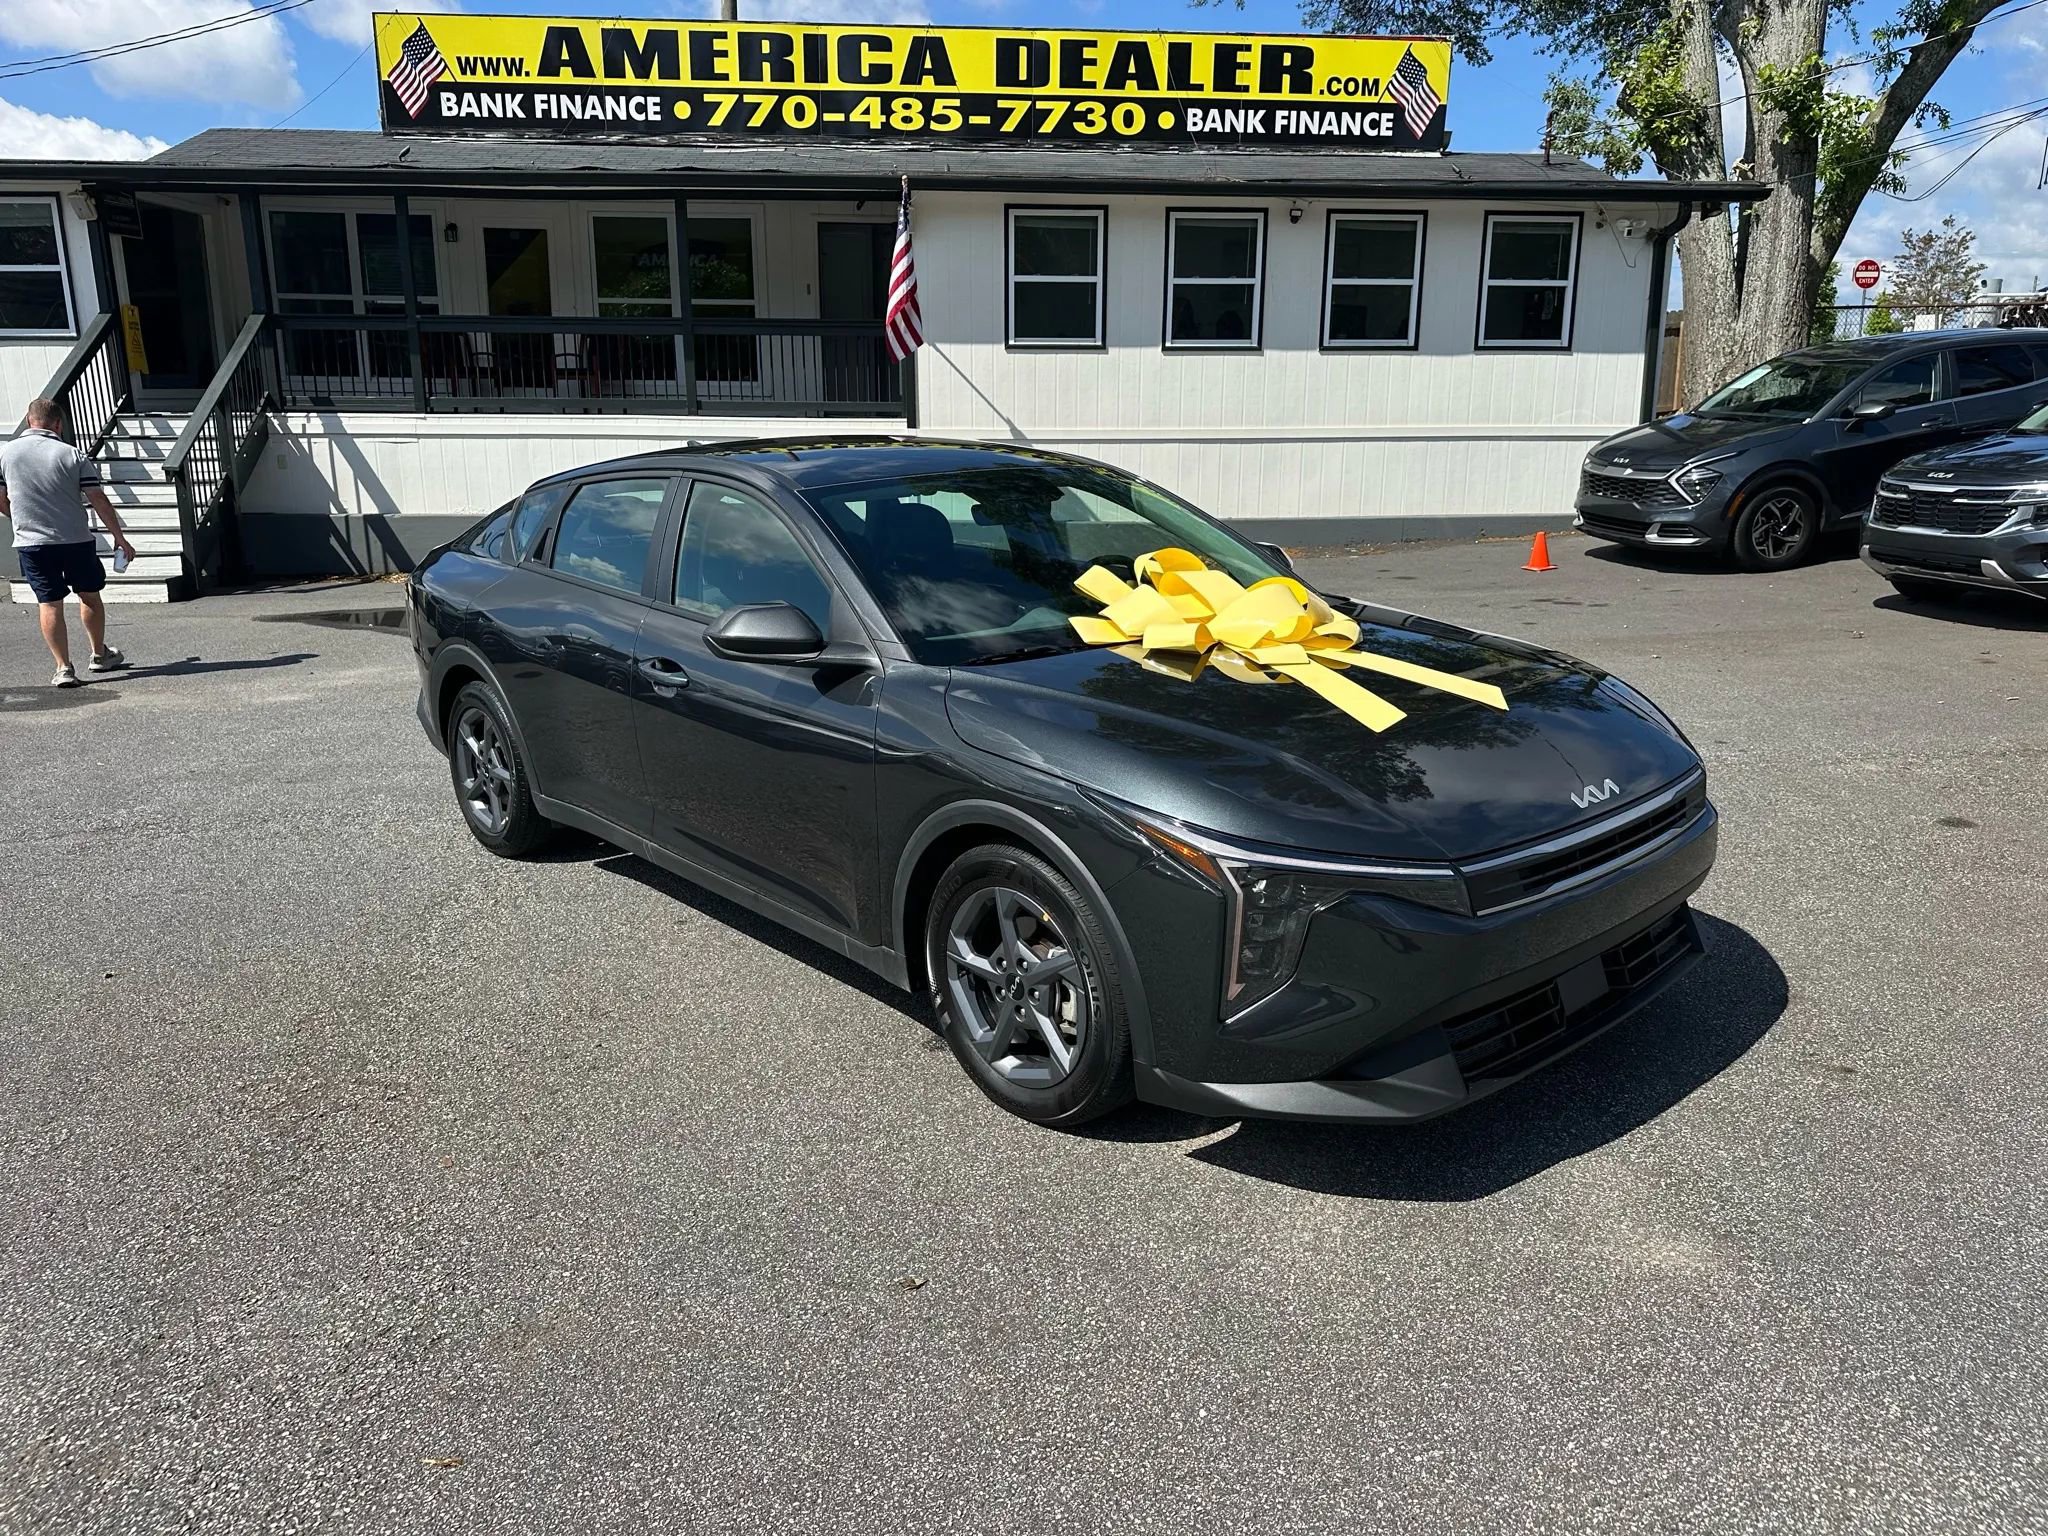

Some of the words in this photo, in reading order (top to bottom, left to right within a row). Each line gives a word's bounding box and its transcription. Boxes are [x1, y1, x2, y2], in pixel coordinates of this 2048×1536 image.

[536, 26, 955, 87] AMERICA
[995, 37, 1313, 95] DEALER
[440, 91, 526, 119] BANK
[534, 93, 661, 121] FINANCE
[703, 94, 1146, 135] 770-485-7730
[1186, 108, 1266, 135] BANK
[1275, 110, 1394, 137] FINANCE
[638, 253, 718, 266] AMICA
[1570, 778, 1619, 809] KIA
